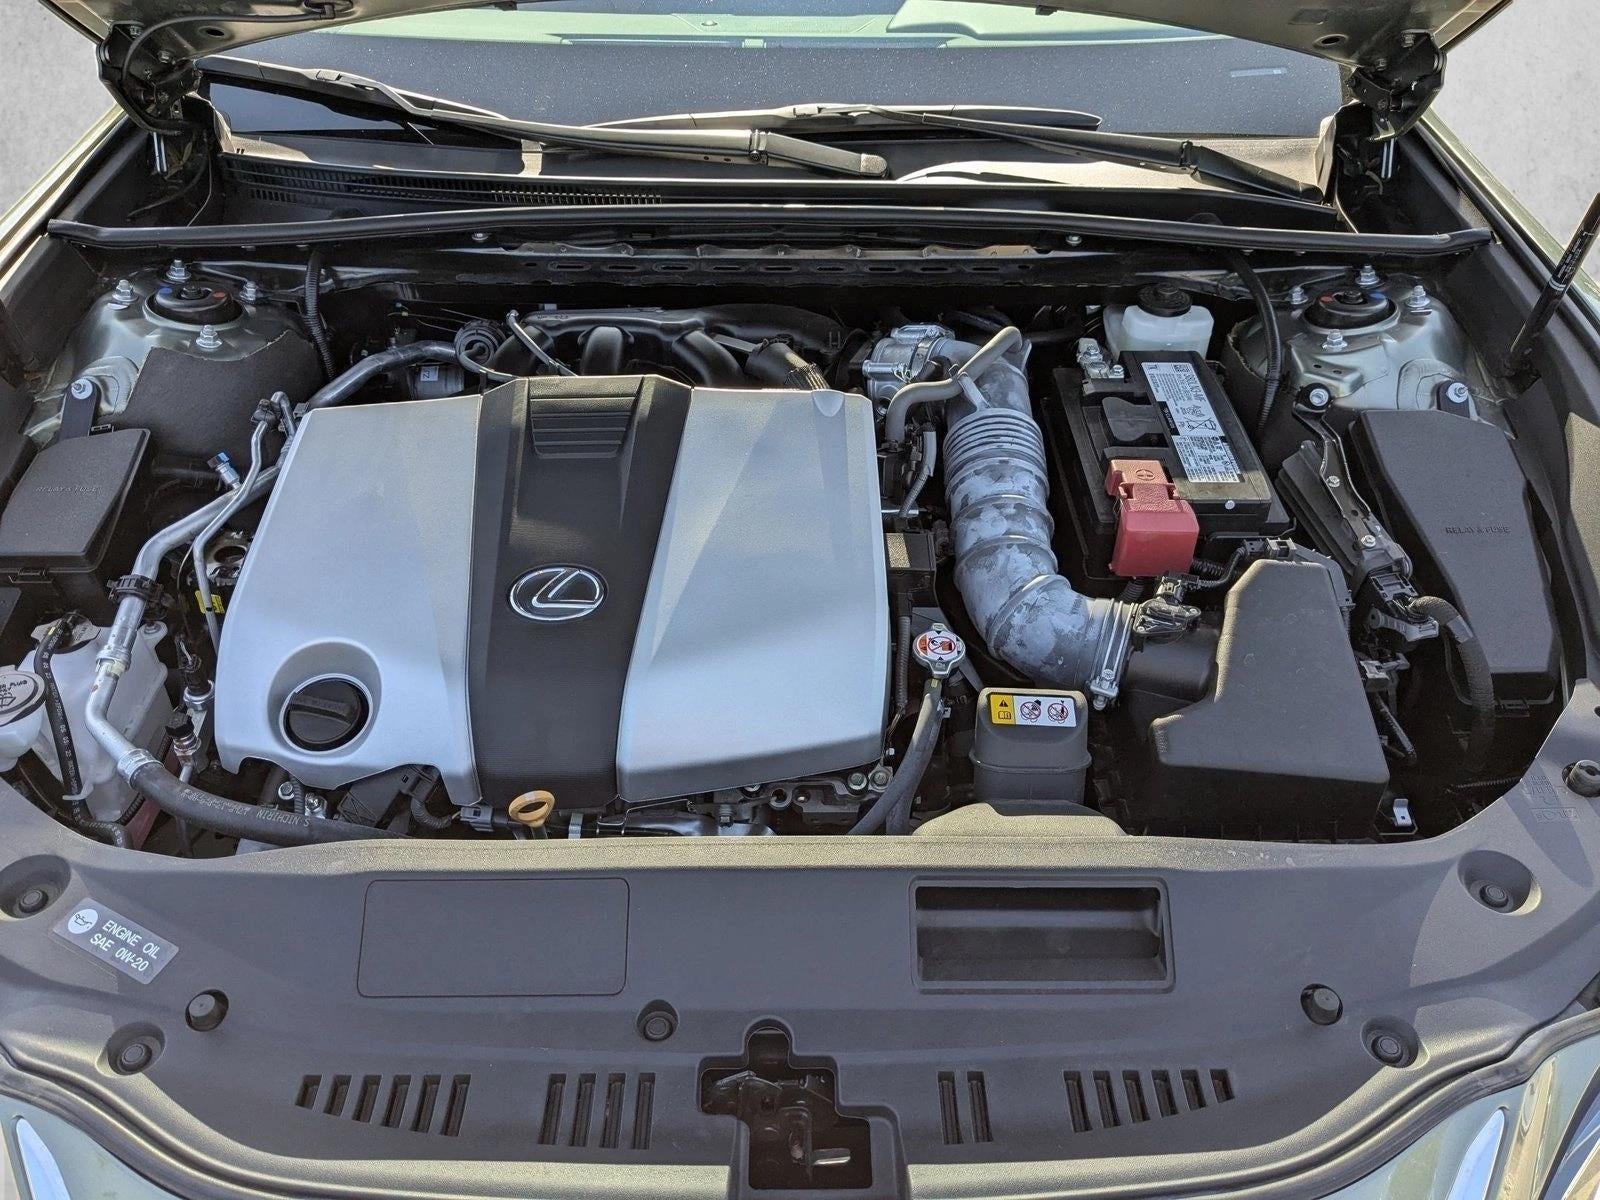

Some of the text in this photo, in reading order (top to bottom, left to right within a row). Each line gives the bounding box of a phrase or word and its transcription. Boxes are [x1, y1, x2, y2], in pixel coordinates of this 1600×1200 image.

[1445, 526, 1474, 534] RELAY
[256, 809, 300, 825] NICHIRIN
[90, 933, 149, 972] SAE 0W-20
[102, 919, 160, 959] ENGINE OIL
